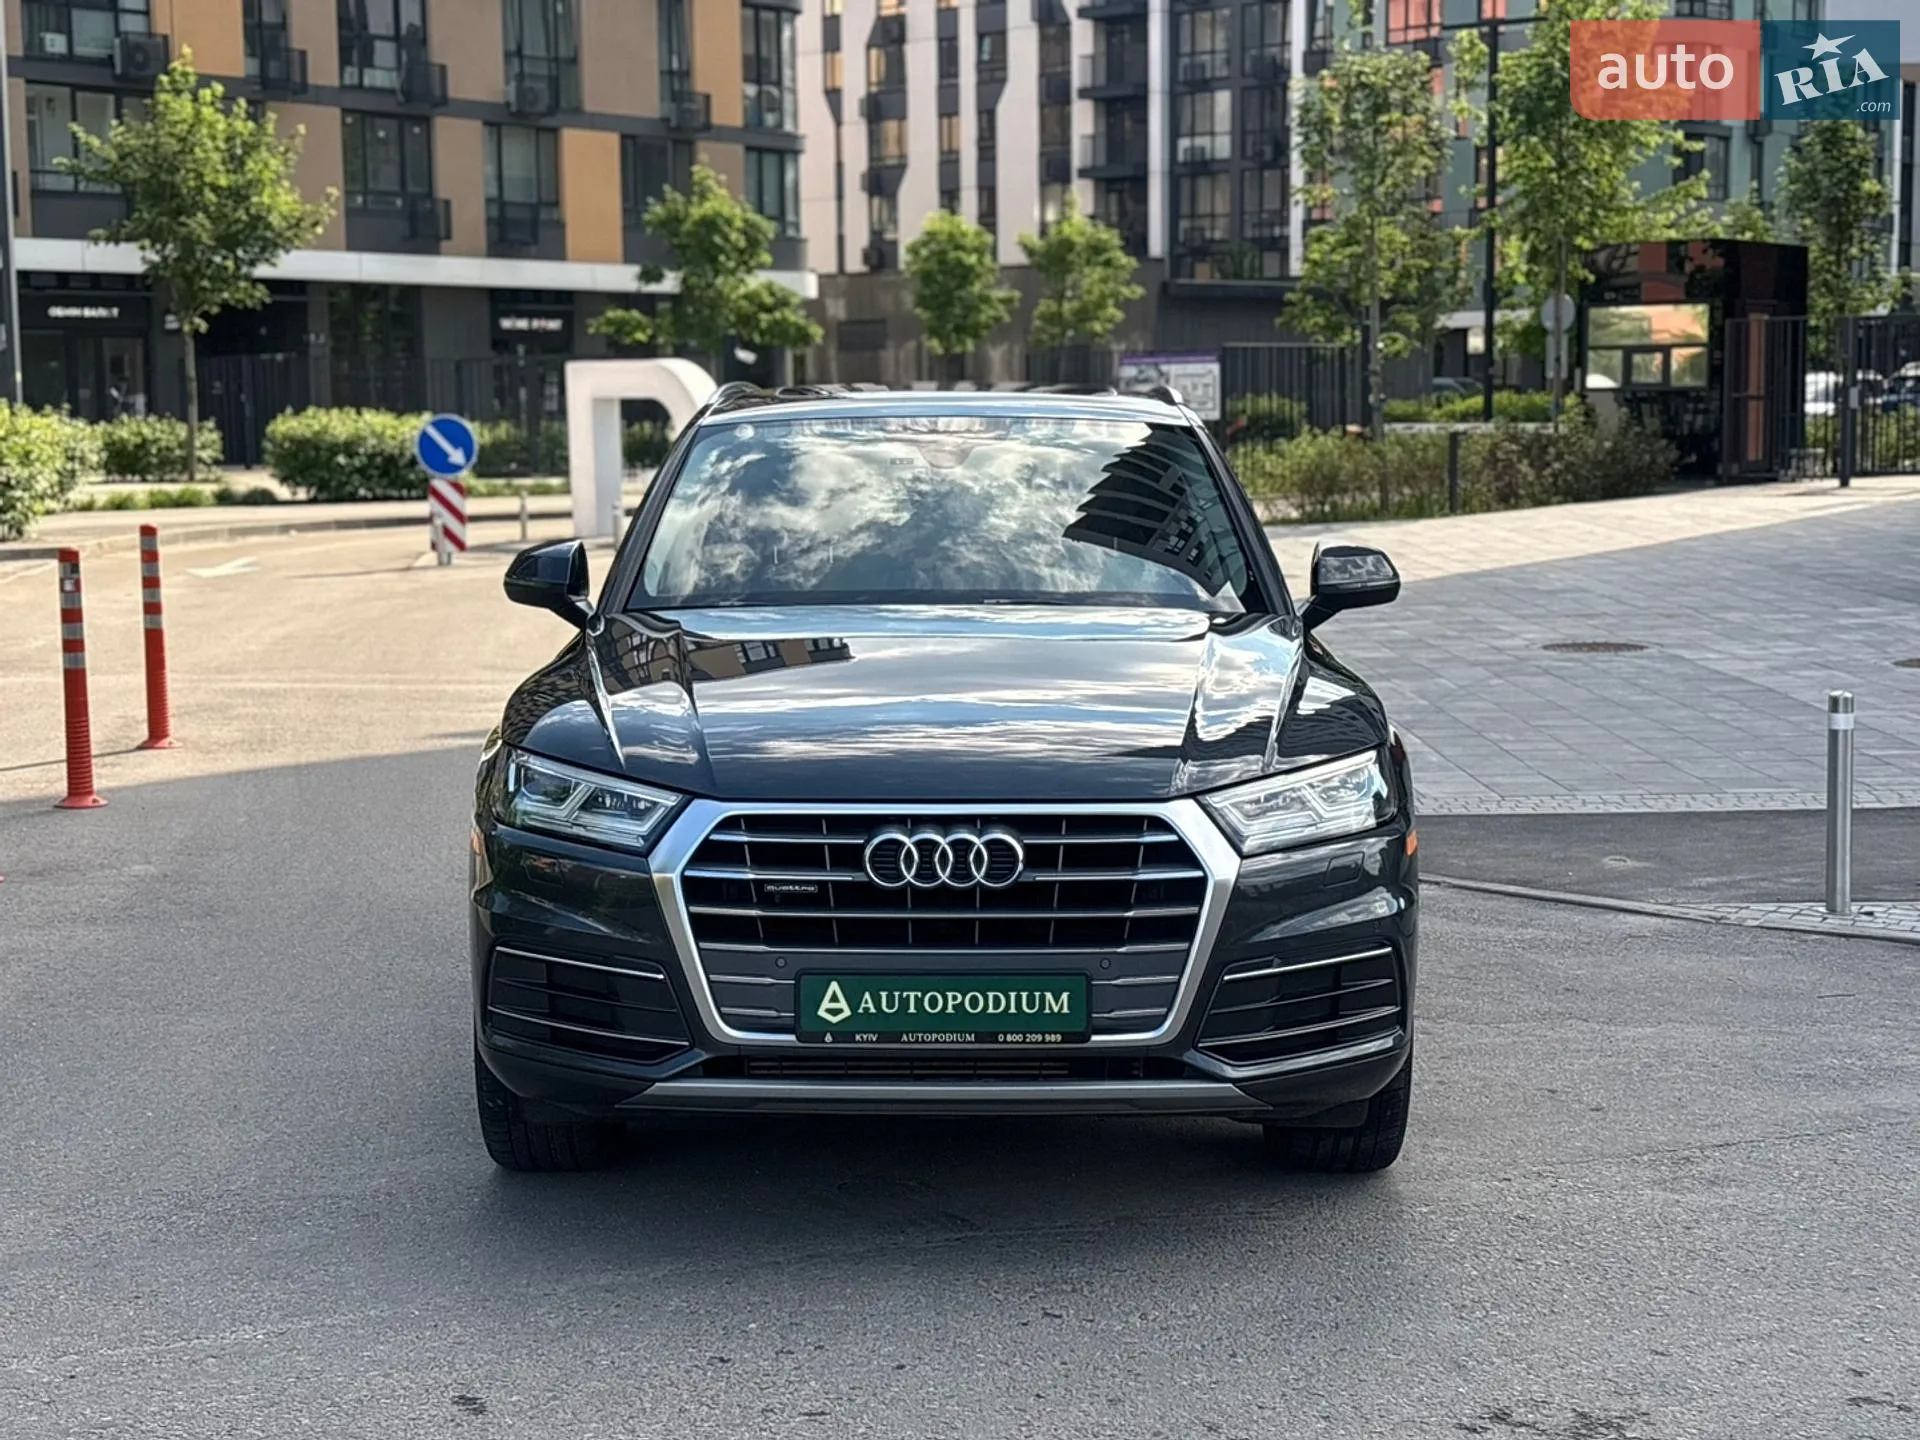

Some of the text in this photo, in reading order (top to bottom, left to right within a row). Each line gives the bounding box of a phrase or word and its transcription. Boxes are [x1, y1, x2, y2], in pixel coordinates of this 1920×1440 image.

[857, 991, 1071, 1014] AUTOPODIUM
[855, 1033, 879, 1042] KYIV
[900, 1033, 975, 1042] AUTOPODIUM
[998, 1033, 1005, 1042] 0
[1006, 1033, 1024, 1042] 800
[1025, 1033, 1043, 1042] 209
